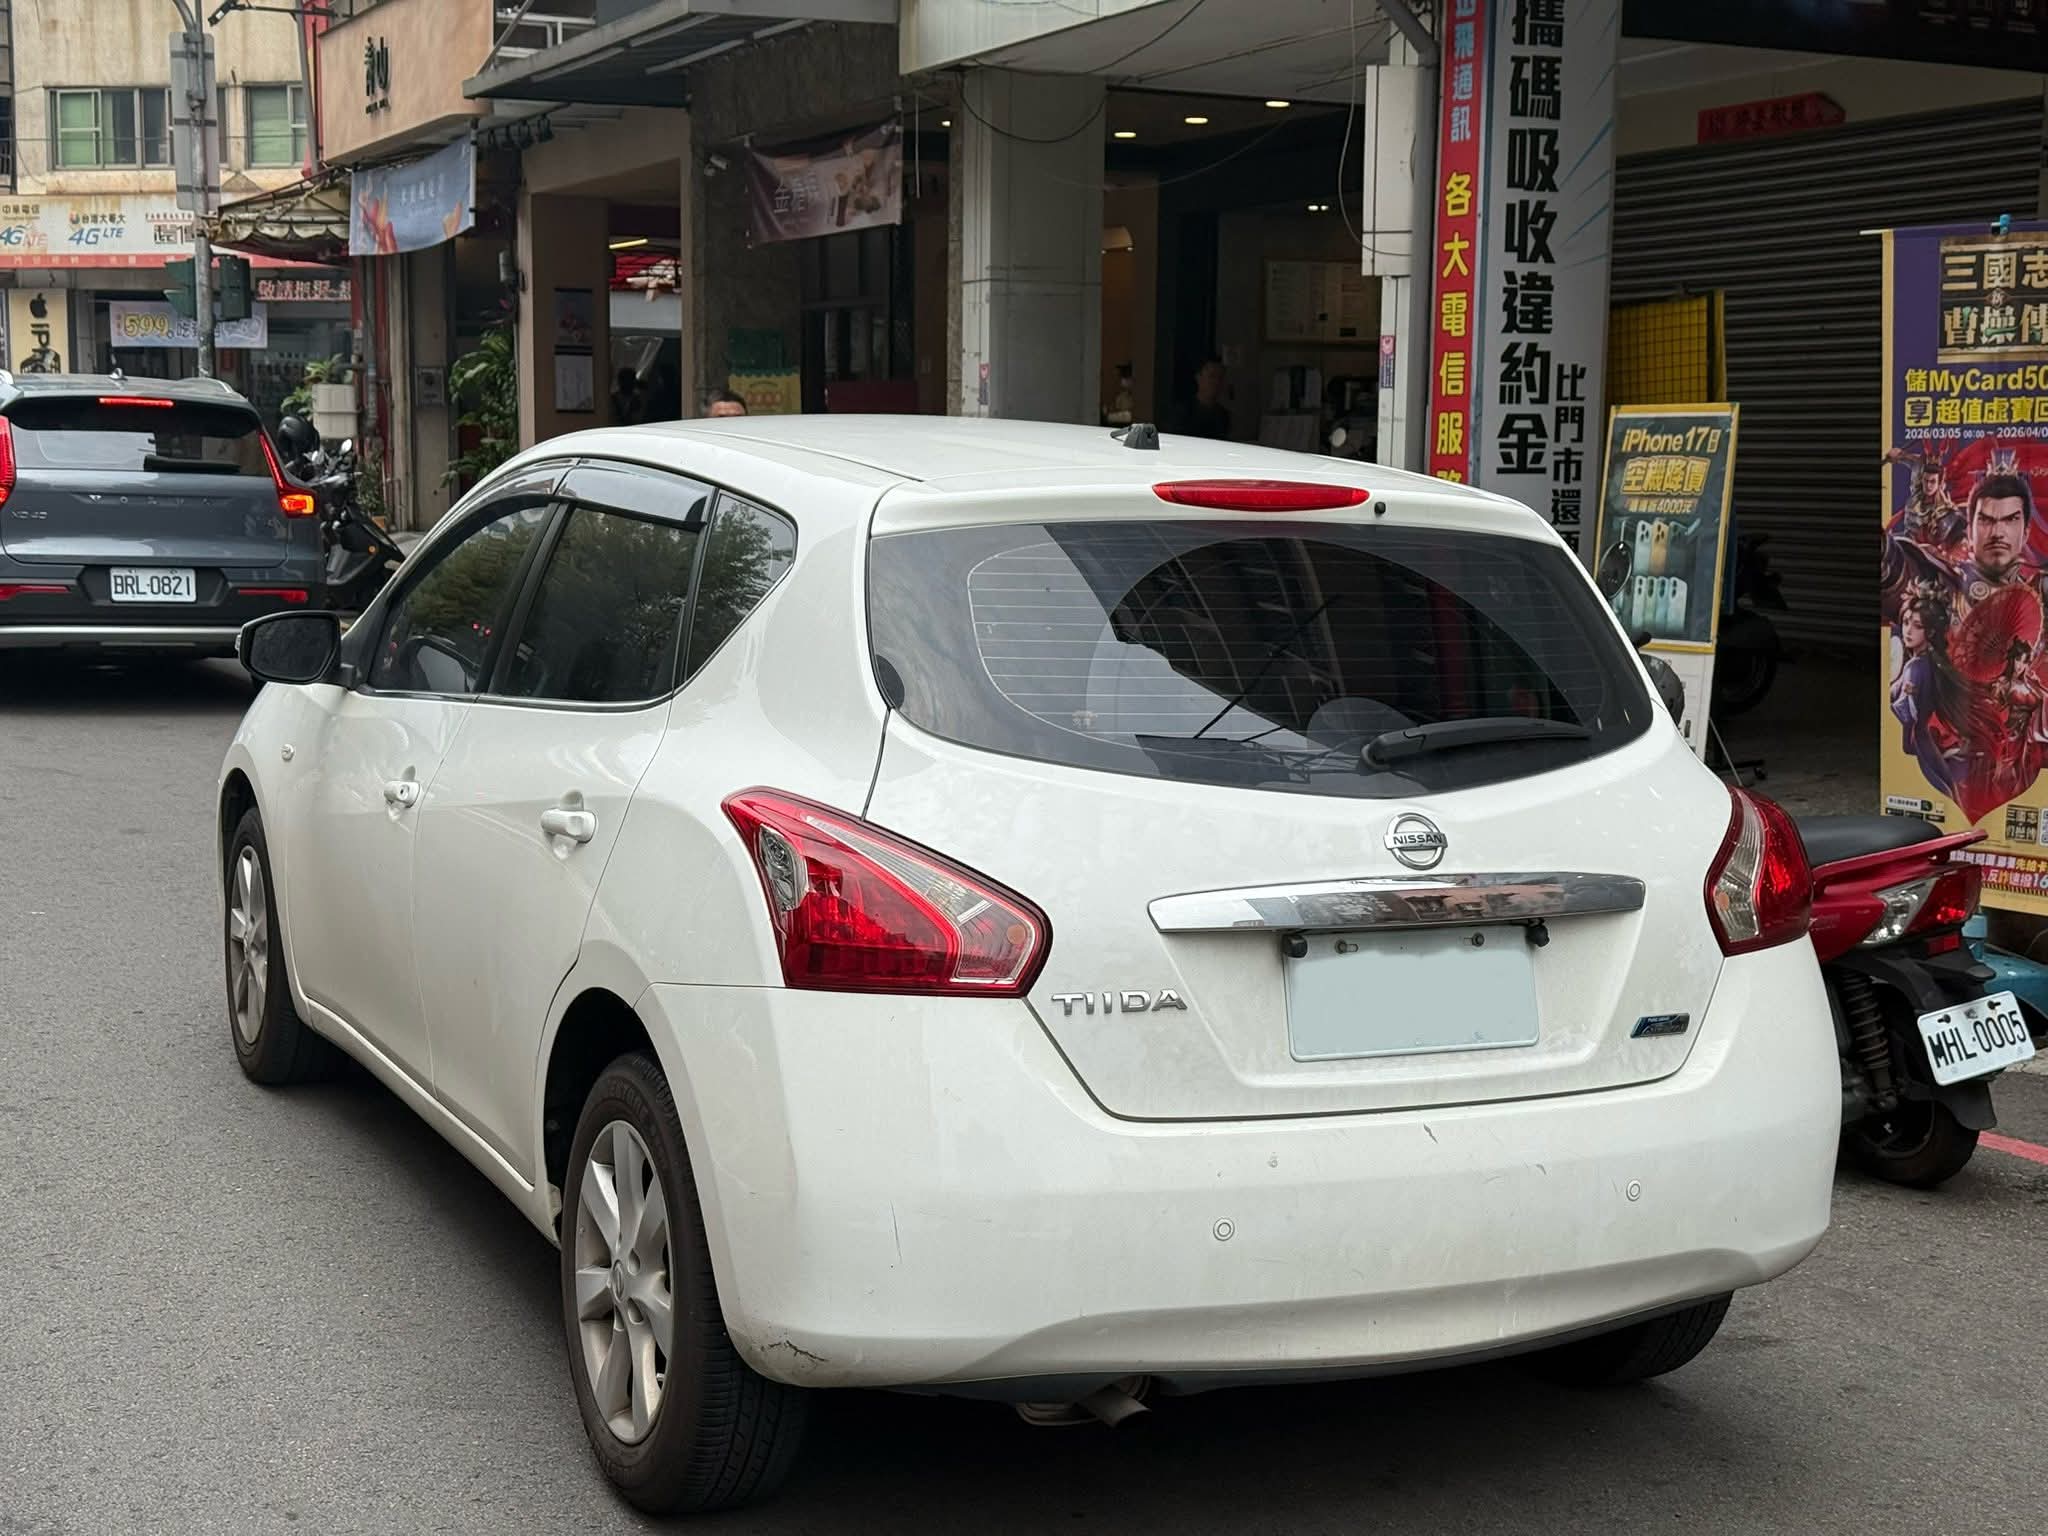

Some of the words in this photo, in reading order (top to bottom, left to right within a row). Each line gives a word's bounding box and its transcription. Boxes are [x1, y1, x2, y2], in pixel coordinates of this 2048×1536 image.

[2, 204, 40, 214] 中華電信
[82, 213, 126, 225] 台灣大哥大
[68, 227, 100, 246] 4G
[103, 227, 124, 239] LTE
[1942, 250, 2048, 291] 三國志
[125, 312, 169, 337] 599
[1905, 427, 1961, 439] 2026/03/05
[1622, 457, 1708, 493] 空機降價
[1392, 833, 1443, 845] NISSAN
[1051, 988, 1188, 1016] TIIDA
